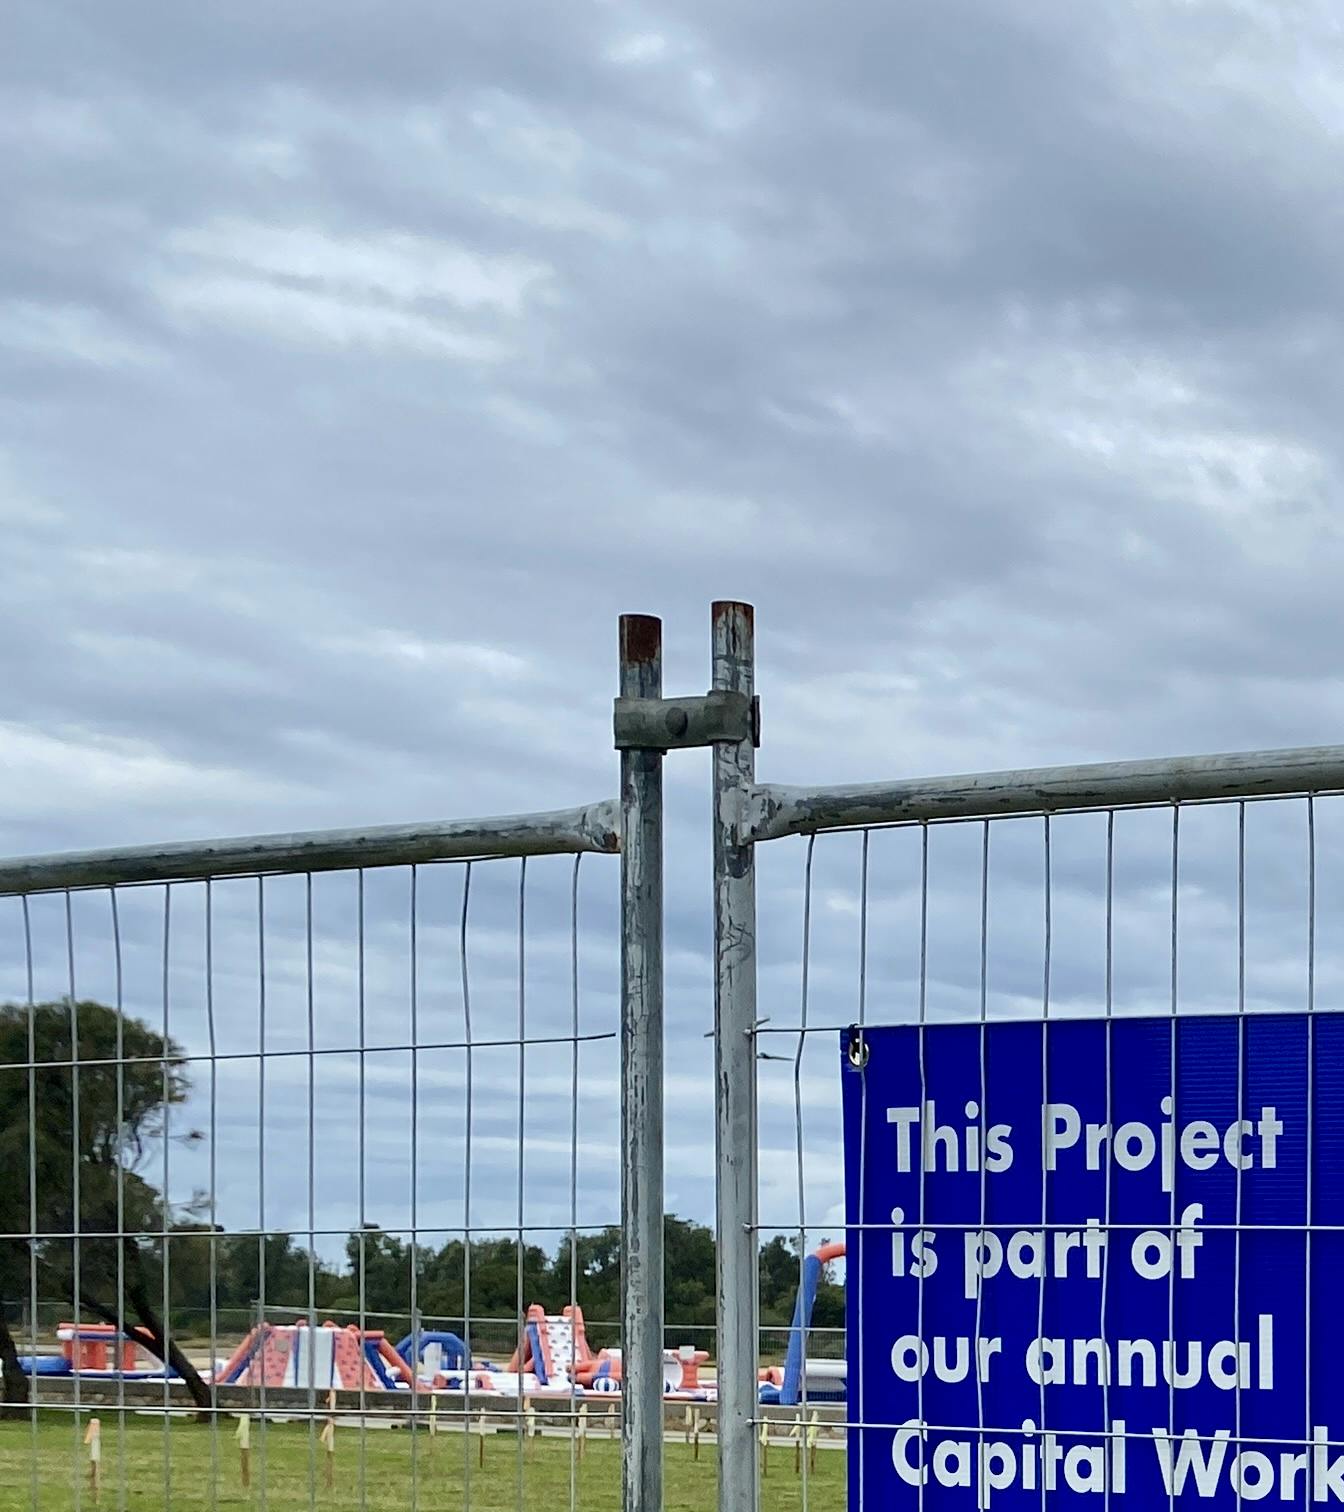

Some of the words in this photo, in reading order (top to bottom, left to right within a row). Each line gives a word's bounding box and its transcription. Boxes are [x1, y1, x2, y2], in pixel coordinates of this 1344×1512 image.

[887, 1100, 1013, 1172] This
[1041, 1096, 1283, 1192] Project
[891, 1207, 938, 1278] is
[964, 1218, 1108, 1299] part
[1131, 1203, 1203, 1280] of
[891, 1335, 1001, 1383] our
[1026, 1314, 1273, 1390] annual
[892, 1419, 1125, 1510] Capital
